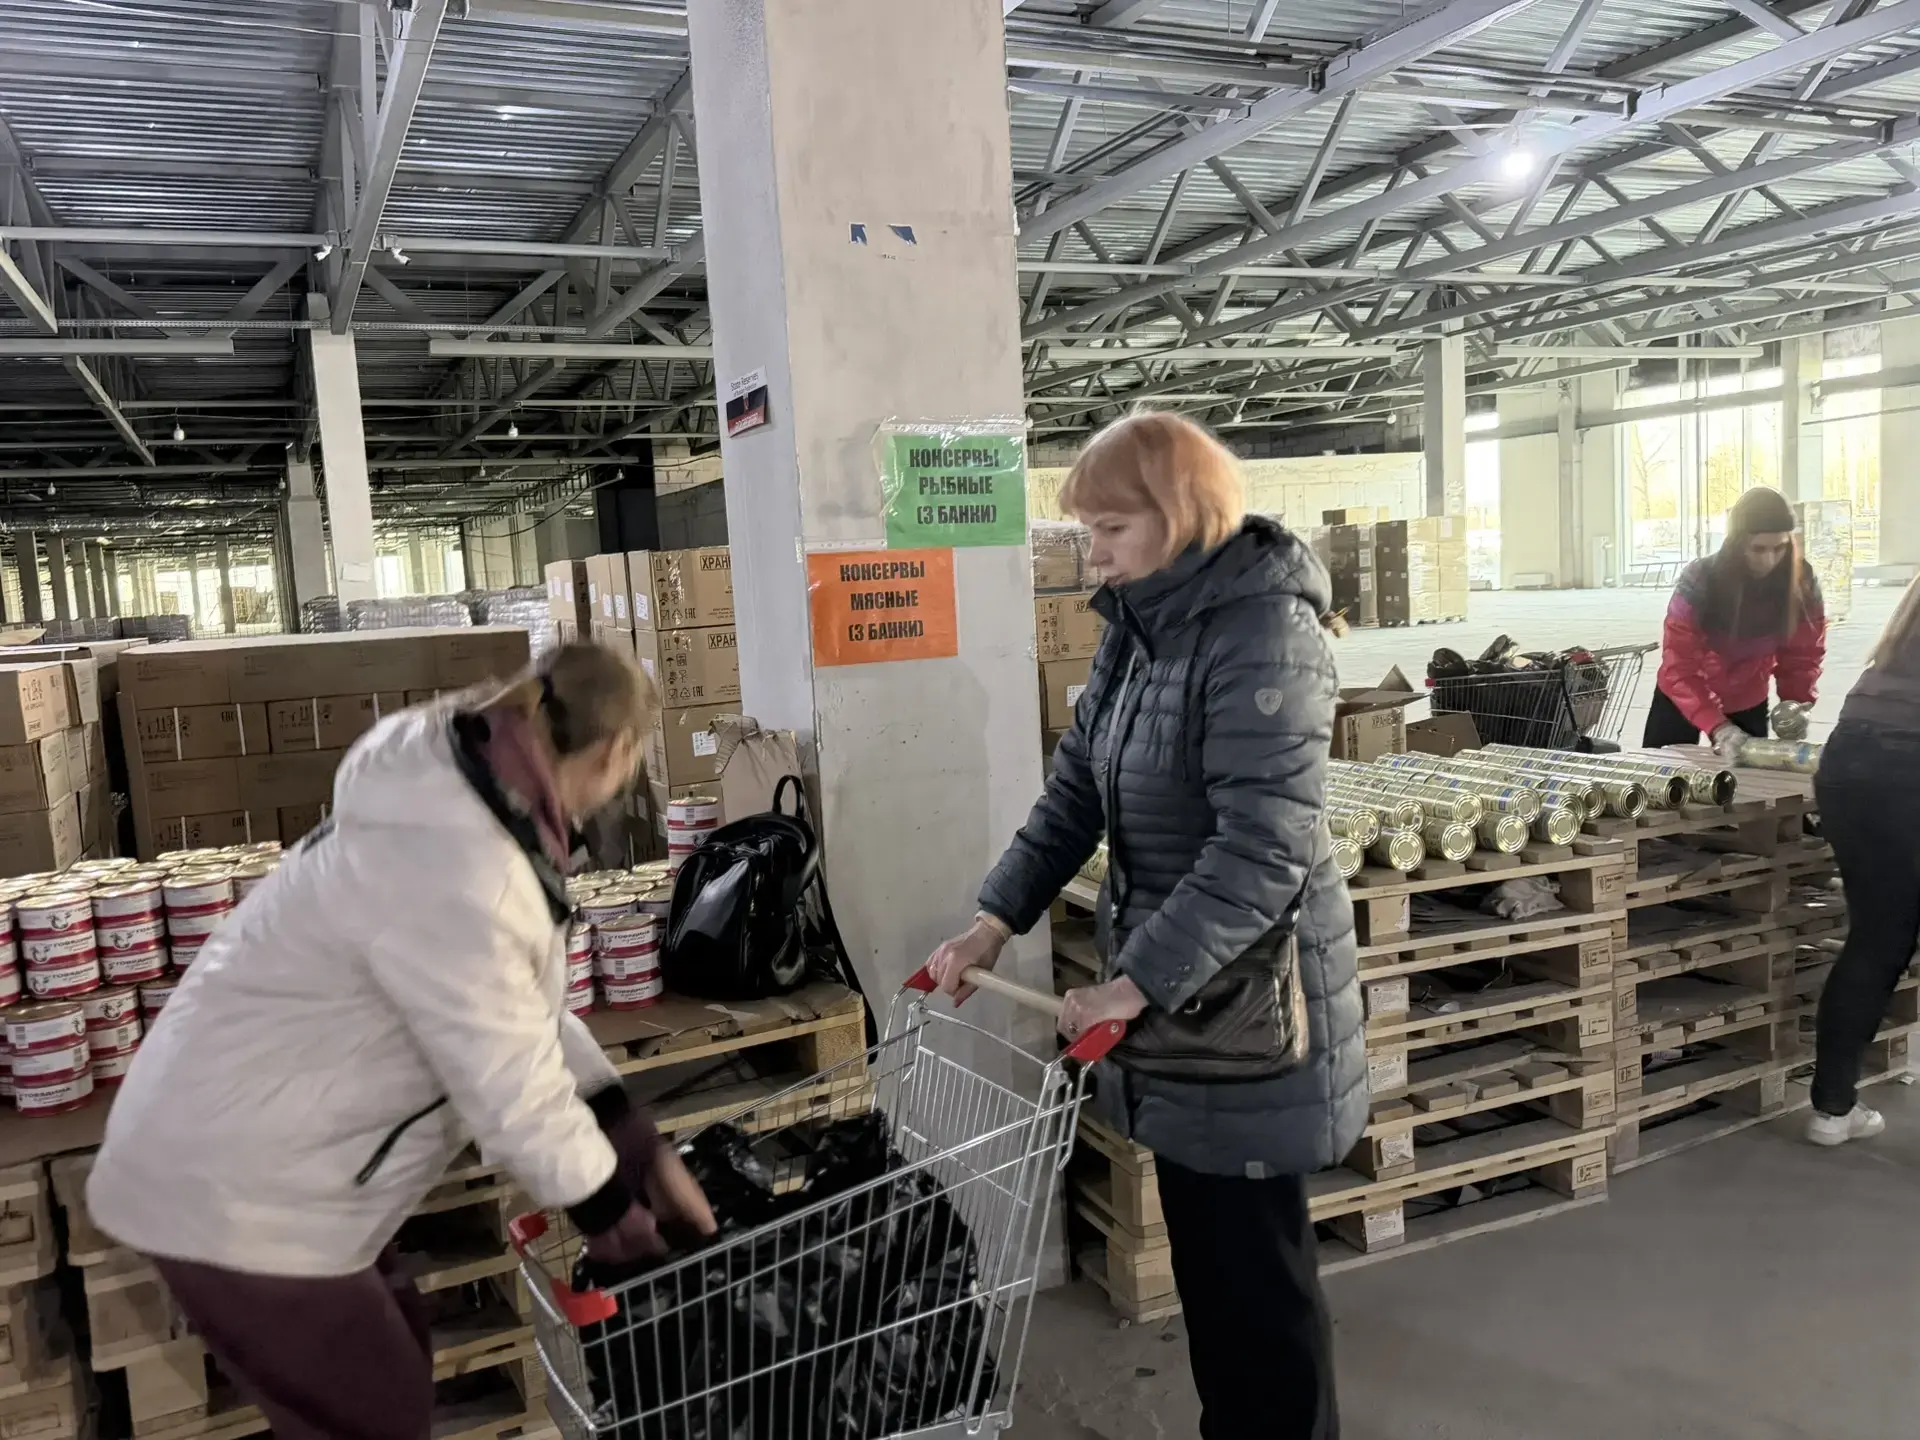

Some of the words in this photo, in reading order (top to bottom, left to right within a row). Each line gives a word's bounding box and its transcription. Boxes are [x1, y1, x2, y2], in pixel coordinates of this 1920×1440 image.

[909, 448, 1000, 469] КОНСЕРВЫ
[918, 476, 994, 496] РЫБНЫЕ
[917, 505, 935, 525] (3
[938, 504, 997, 525] БАНКИ)
[839, 560, 925, 583] КОНСЕРВЫ
[850, 590, 919, 612] МЯСНЫЕ
[848, 621, 865, 642] (3
[867, 619, 924, 641] БАНКИ)
